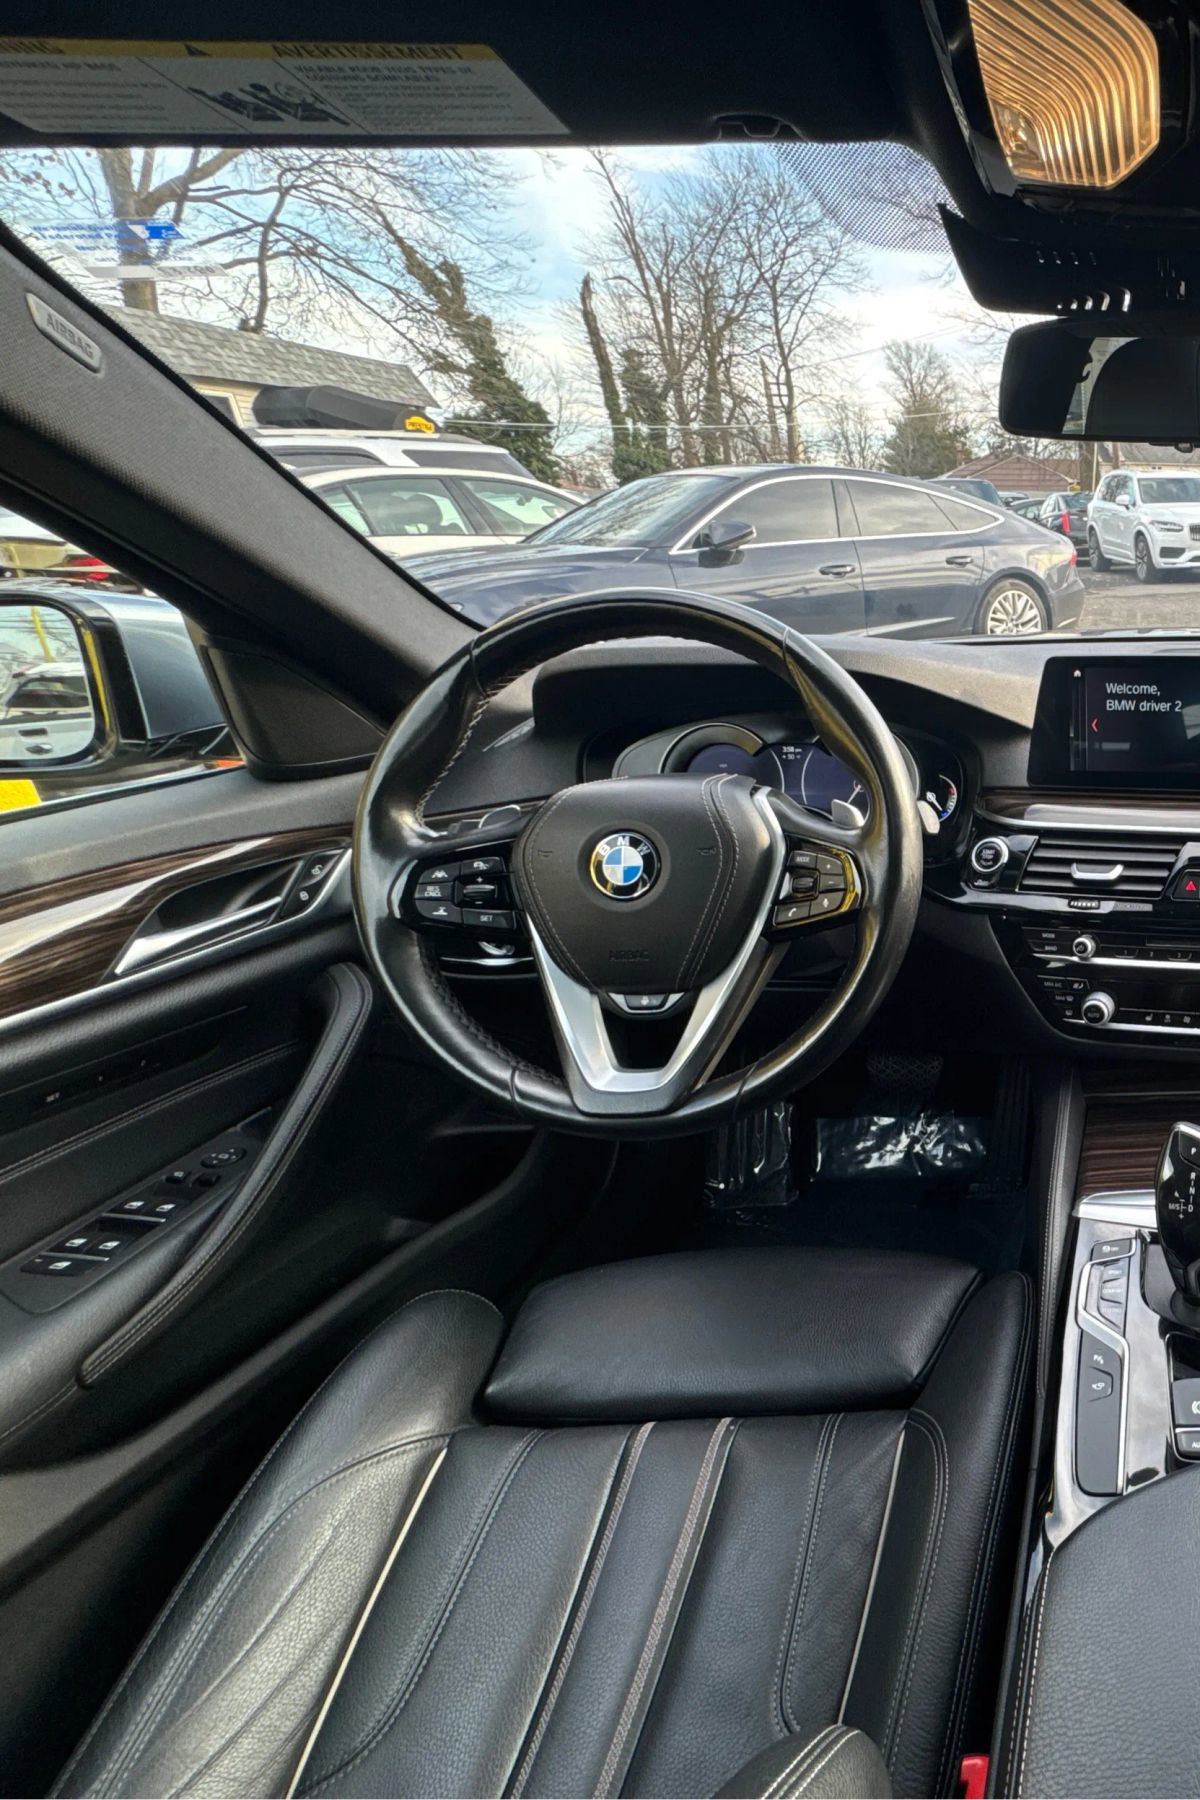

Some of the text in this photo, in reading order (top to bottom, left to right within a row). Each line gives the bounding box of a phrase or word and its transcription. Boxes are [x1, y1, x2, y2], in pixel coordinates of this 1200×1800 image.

[271, 44, 464, 60] AVERTISSEMENT
[46, 312, 95, 360] AIRBAG
[1105, 682, 1161, 696] Welcome,
[1106, 699, 1182, 712] BMW driver 2
[598, 836, 650, 856] BMW
[1191, 1147, 1197, 1155] P
[1190, 1172, 1196, 1180] R
